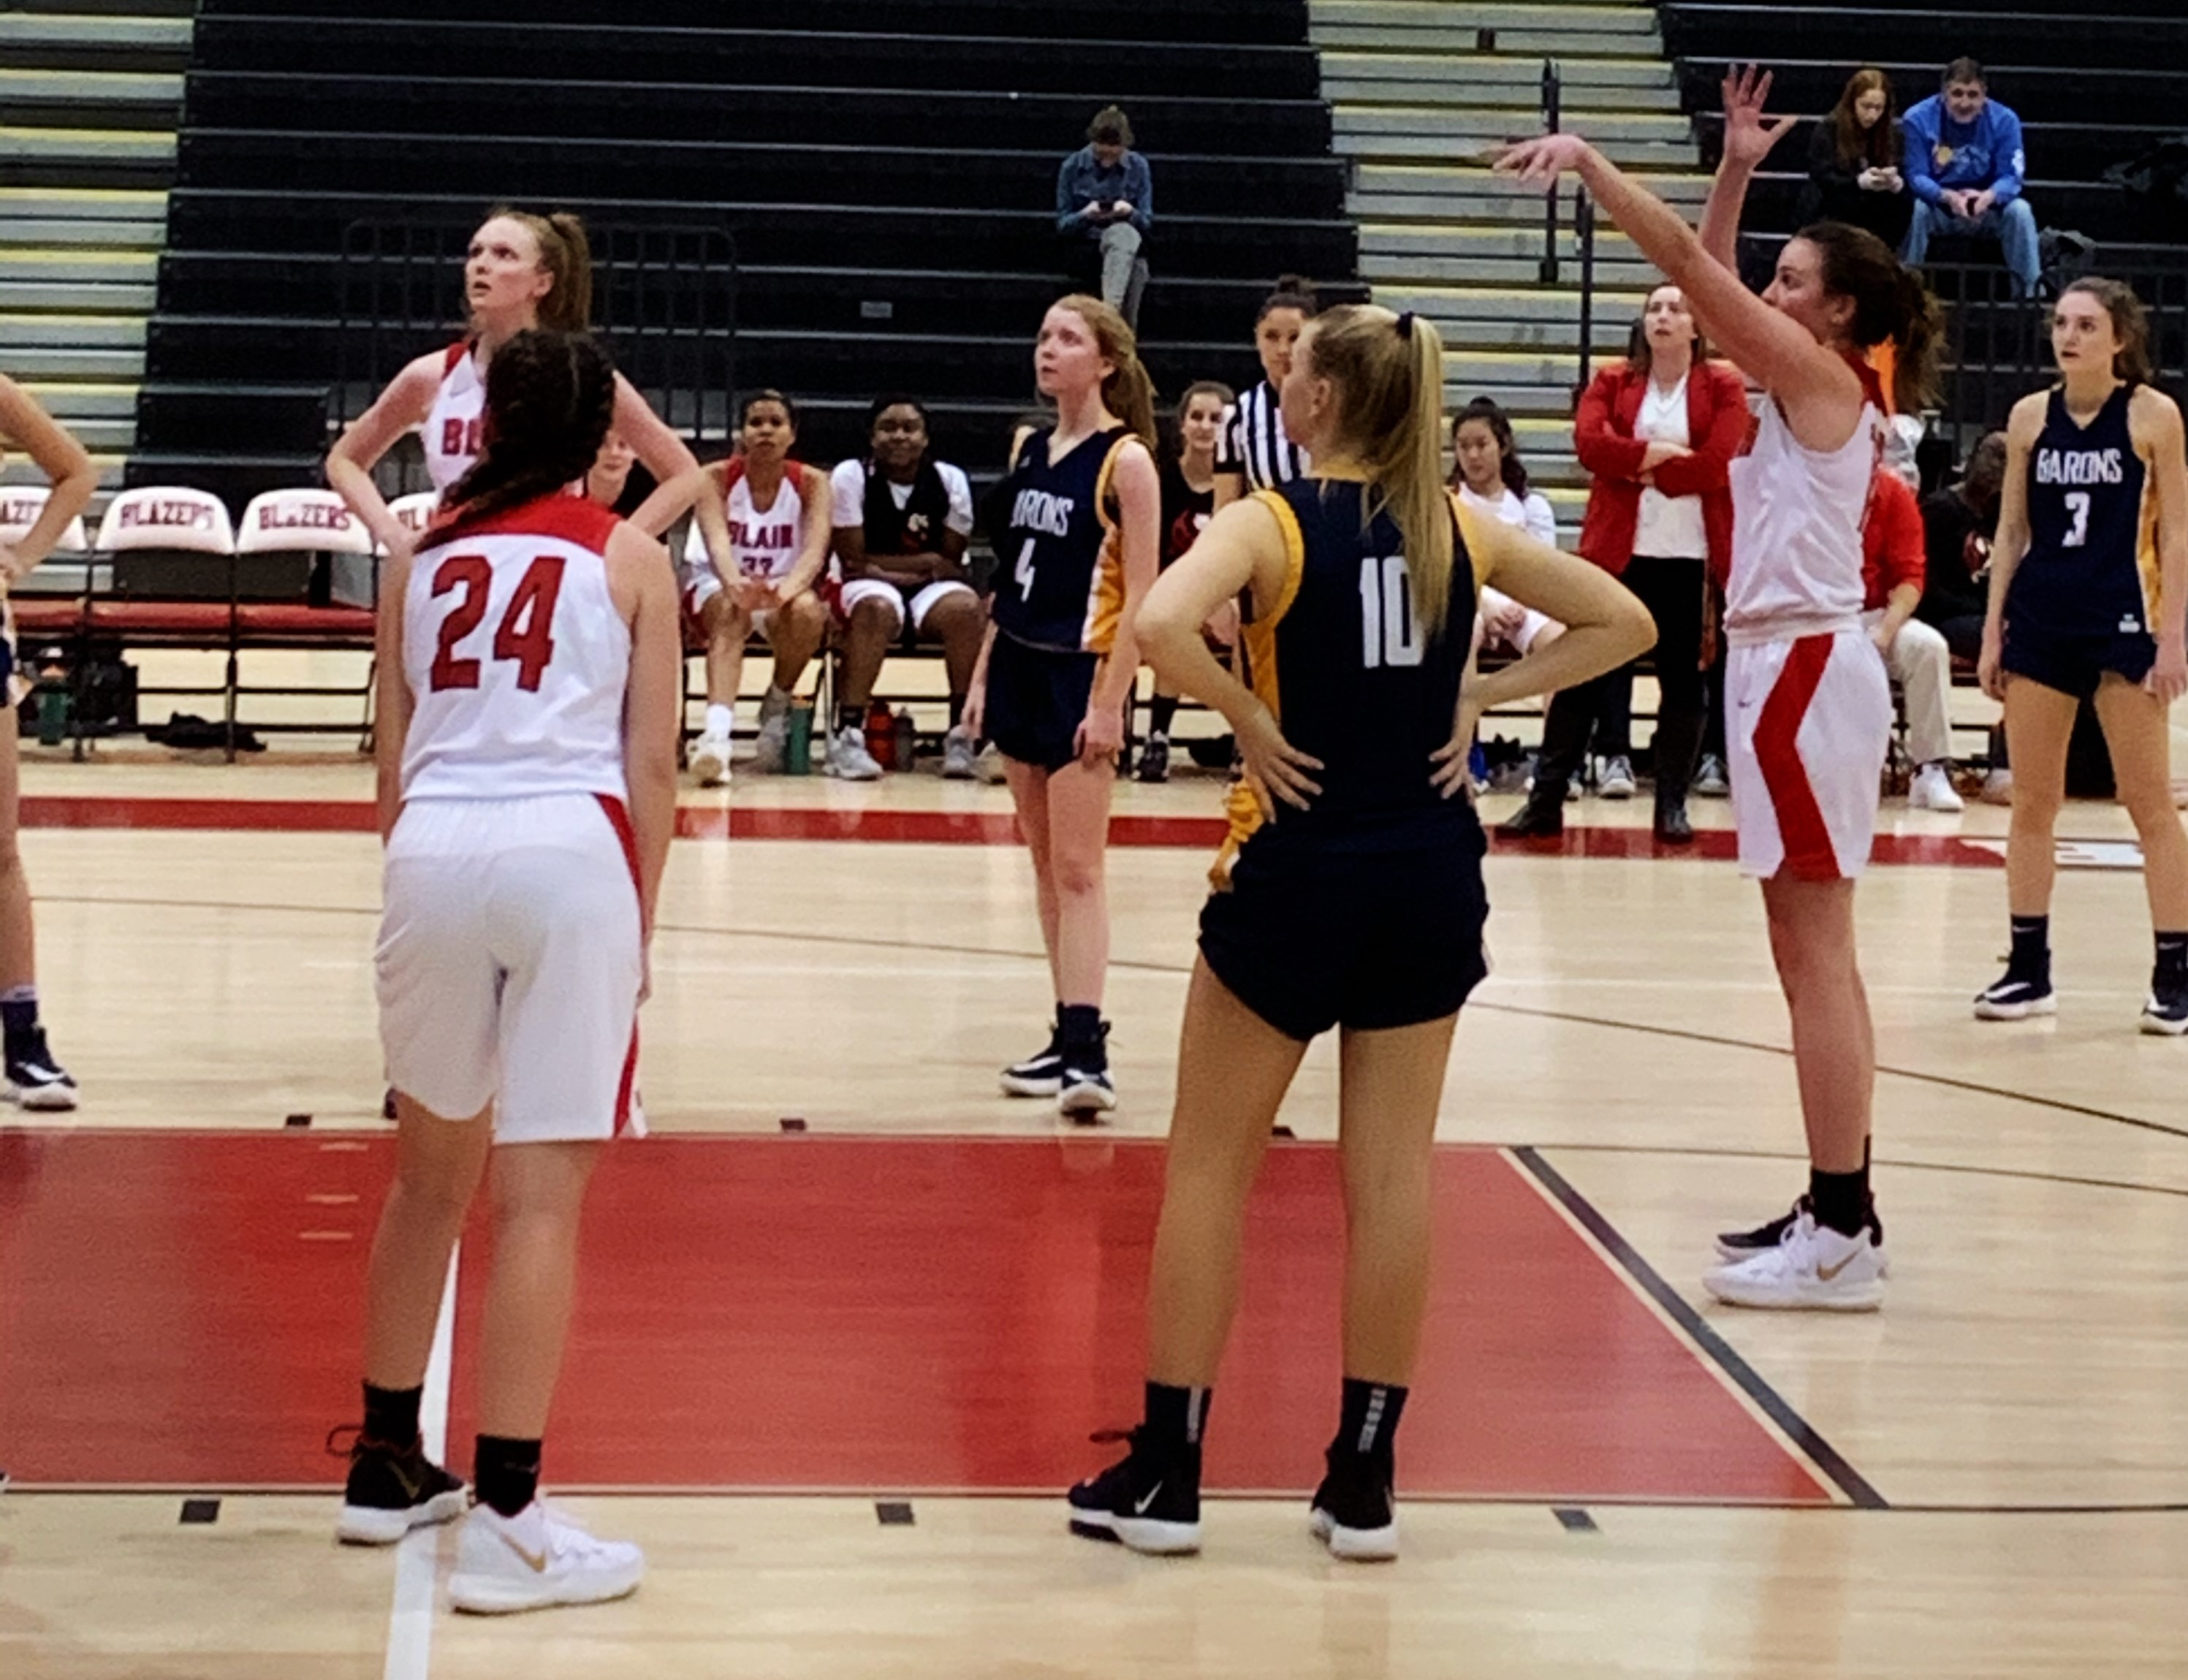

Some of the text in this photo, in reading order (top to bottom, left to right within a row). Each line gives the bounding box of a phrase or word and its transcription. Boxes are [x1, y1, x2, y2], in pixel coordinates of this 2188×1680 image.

[441, 417, 483, 457] BL
[2035, 447, 2123, 484] BARONS
[259, 503, 351, 531] BLAZERS
[1009, 487, 1075, 538] ARONS
[2061, 490, 2091, 547] 3
[1014, 538, 1036, 602] 4
[430, 555, 567, 693] 24
[1359, 555, 1424, 669] 10
